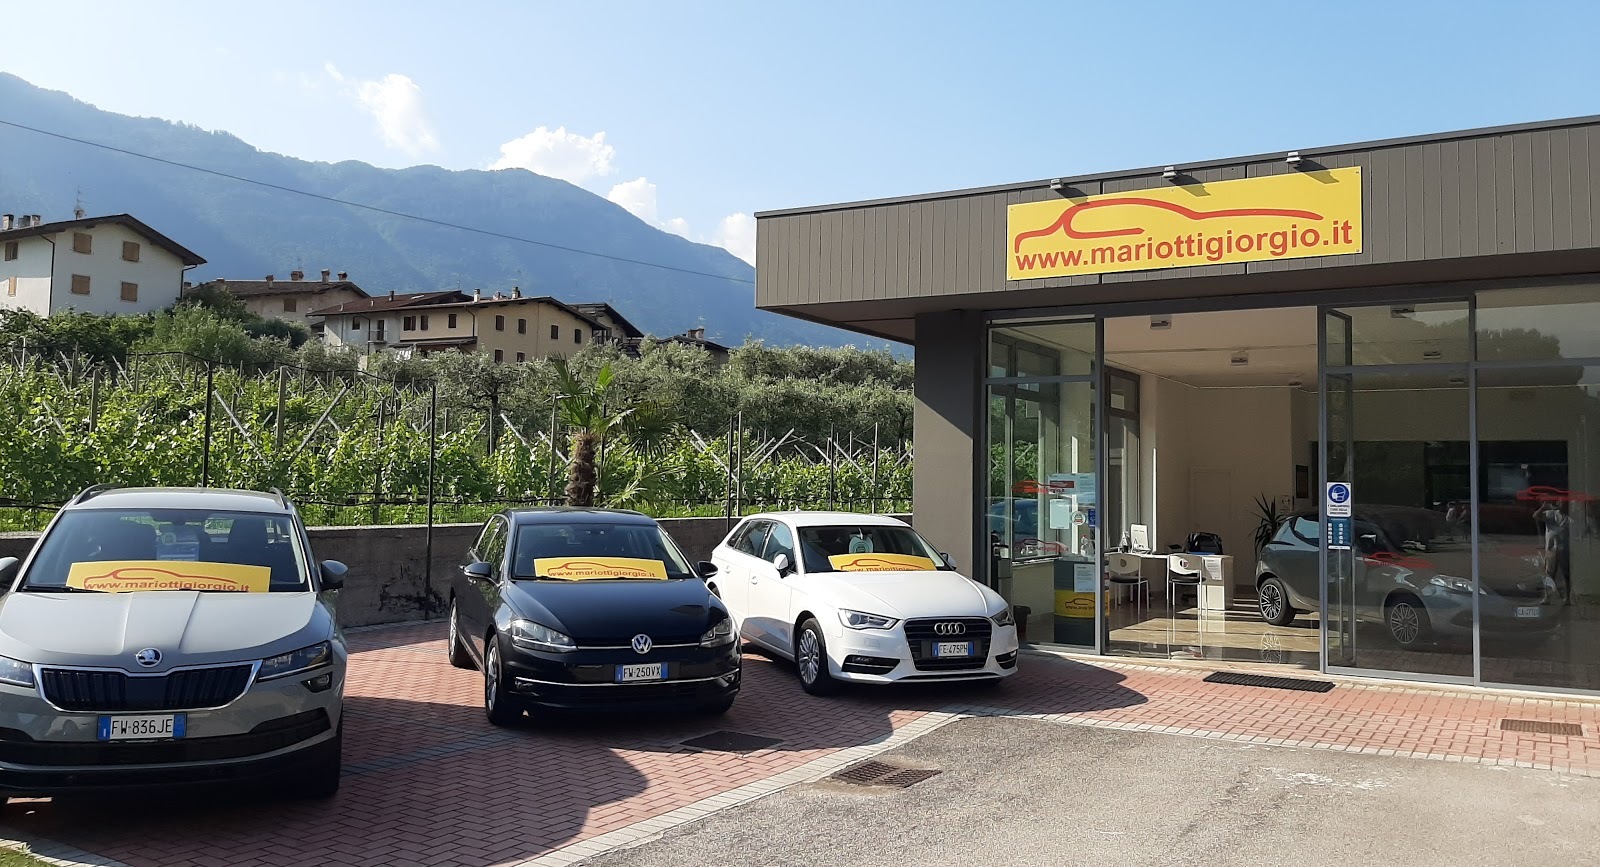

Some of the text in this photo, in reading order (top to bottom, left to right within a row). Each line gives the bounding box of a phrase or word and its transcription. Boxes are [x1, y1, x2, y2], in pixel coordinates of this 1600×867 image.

[1015, 219, 1353, 271] www.mariottigiorgio.it
[548, 569, 656, 578] www.mariottigiorgio.it
[85, 580, 250, 591] www.mariottigiorgio.it
